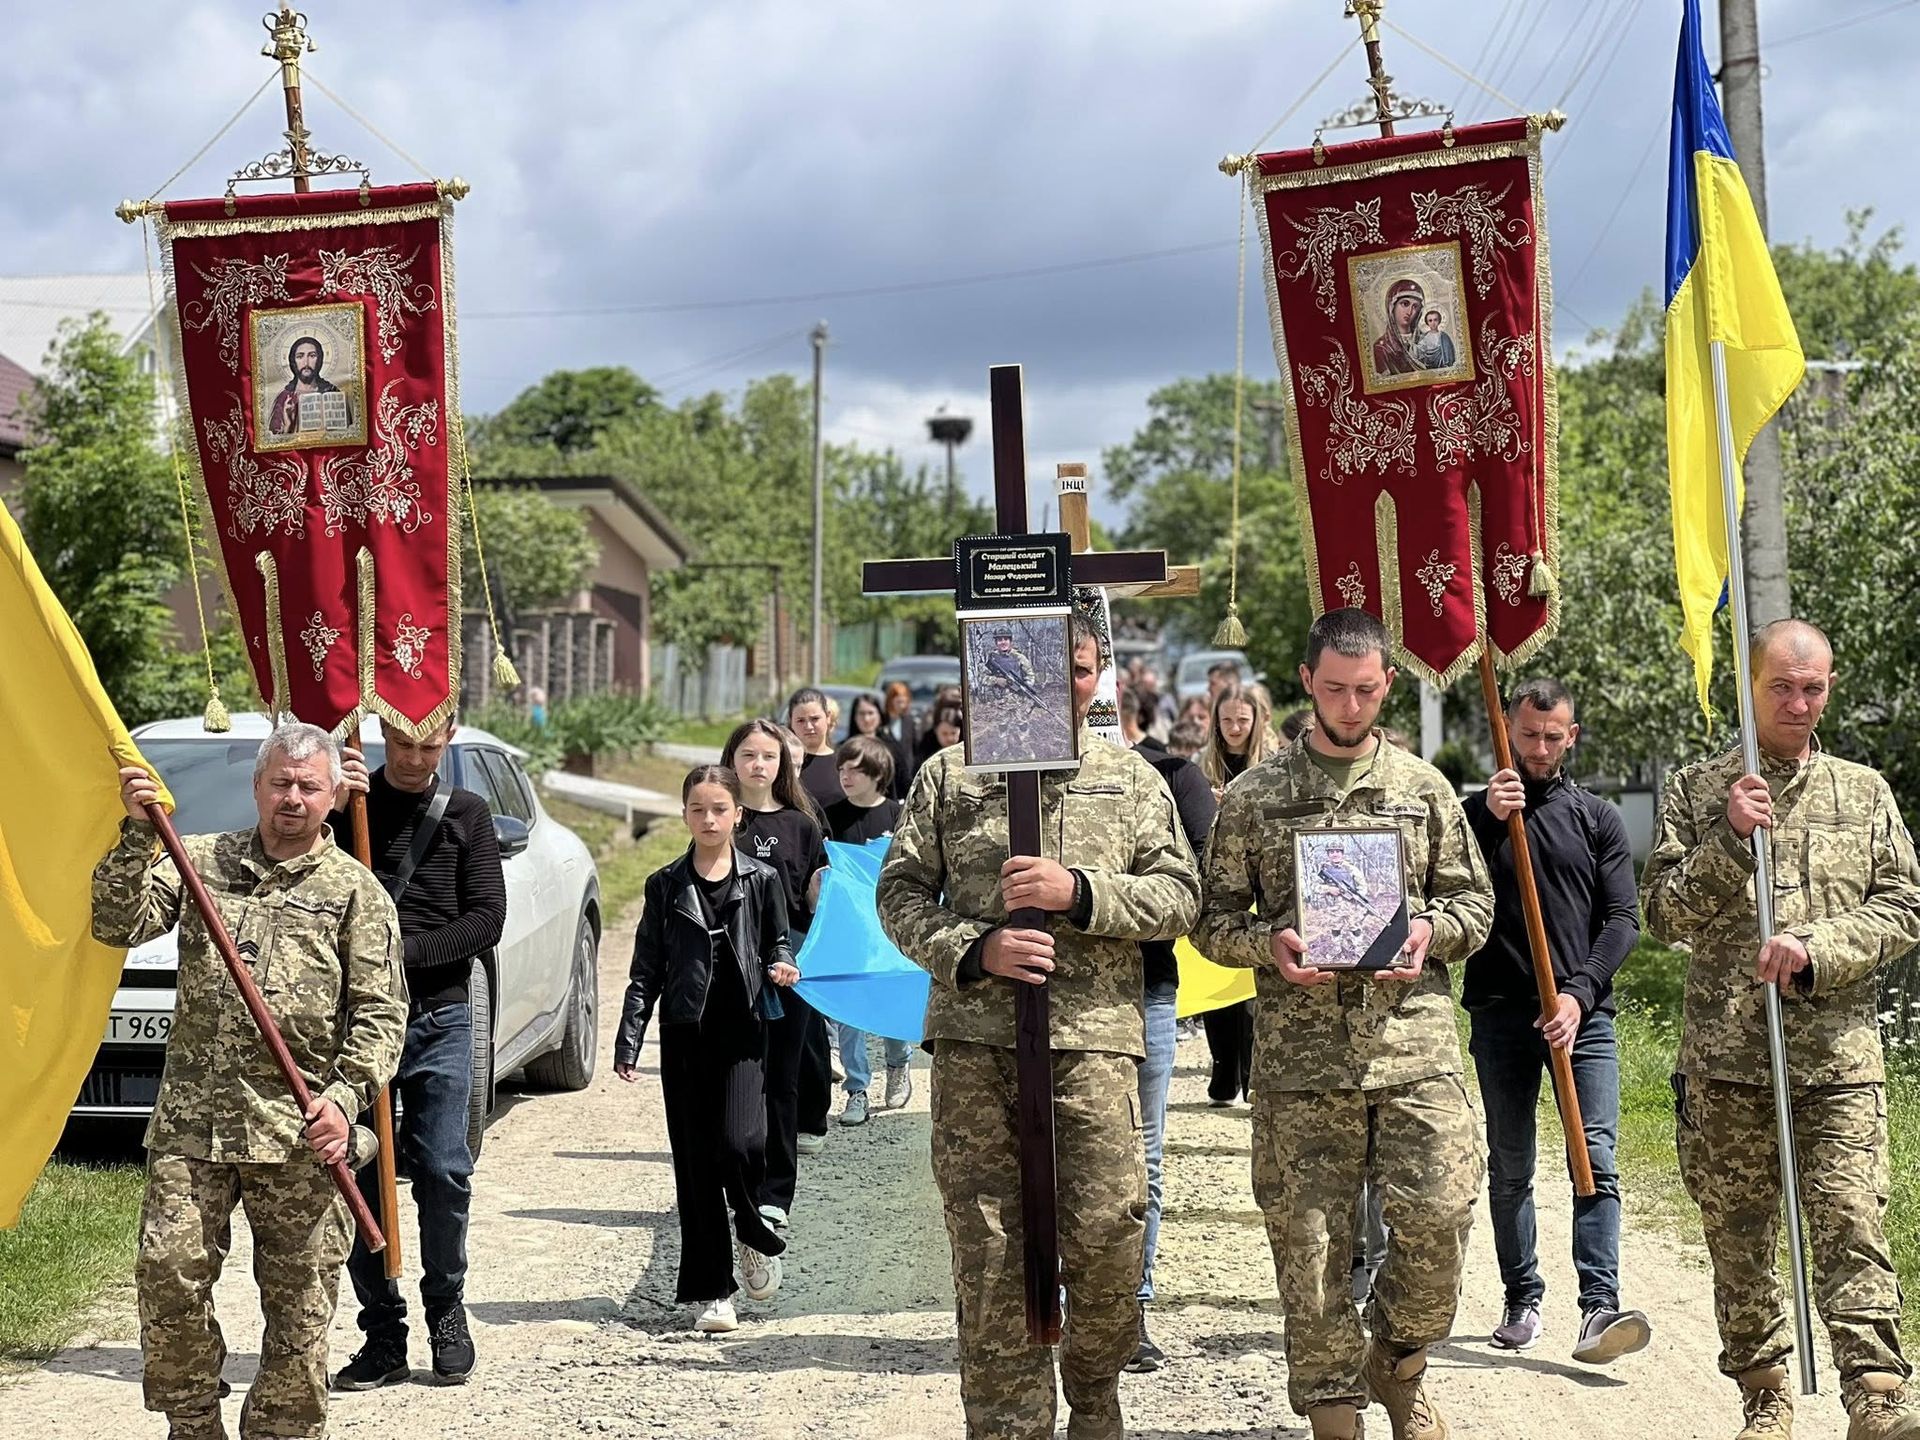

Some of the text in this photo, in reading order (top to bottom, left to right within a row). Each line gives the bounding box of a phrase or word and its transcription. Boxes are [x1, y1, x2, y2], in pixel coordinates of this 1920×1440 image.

[981, 551, 1046, 561] Старший солдат
[988, 561, 1038, 571] Малецький
